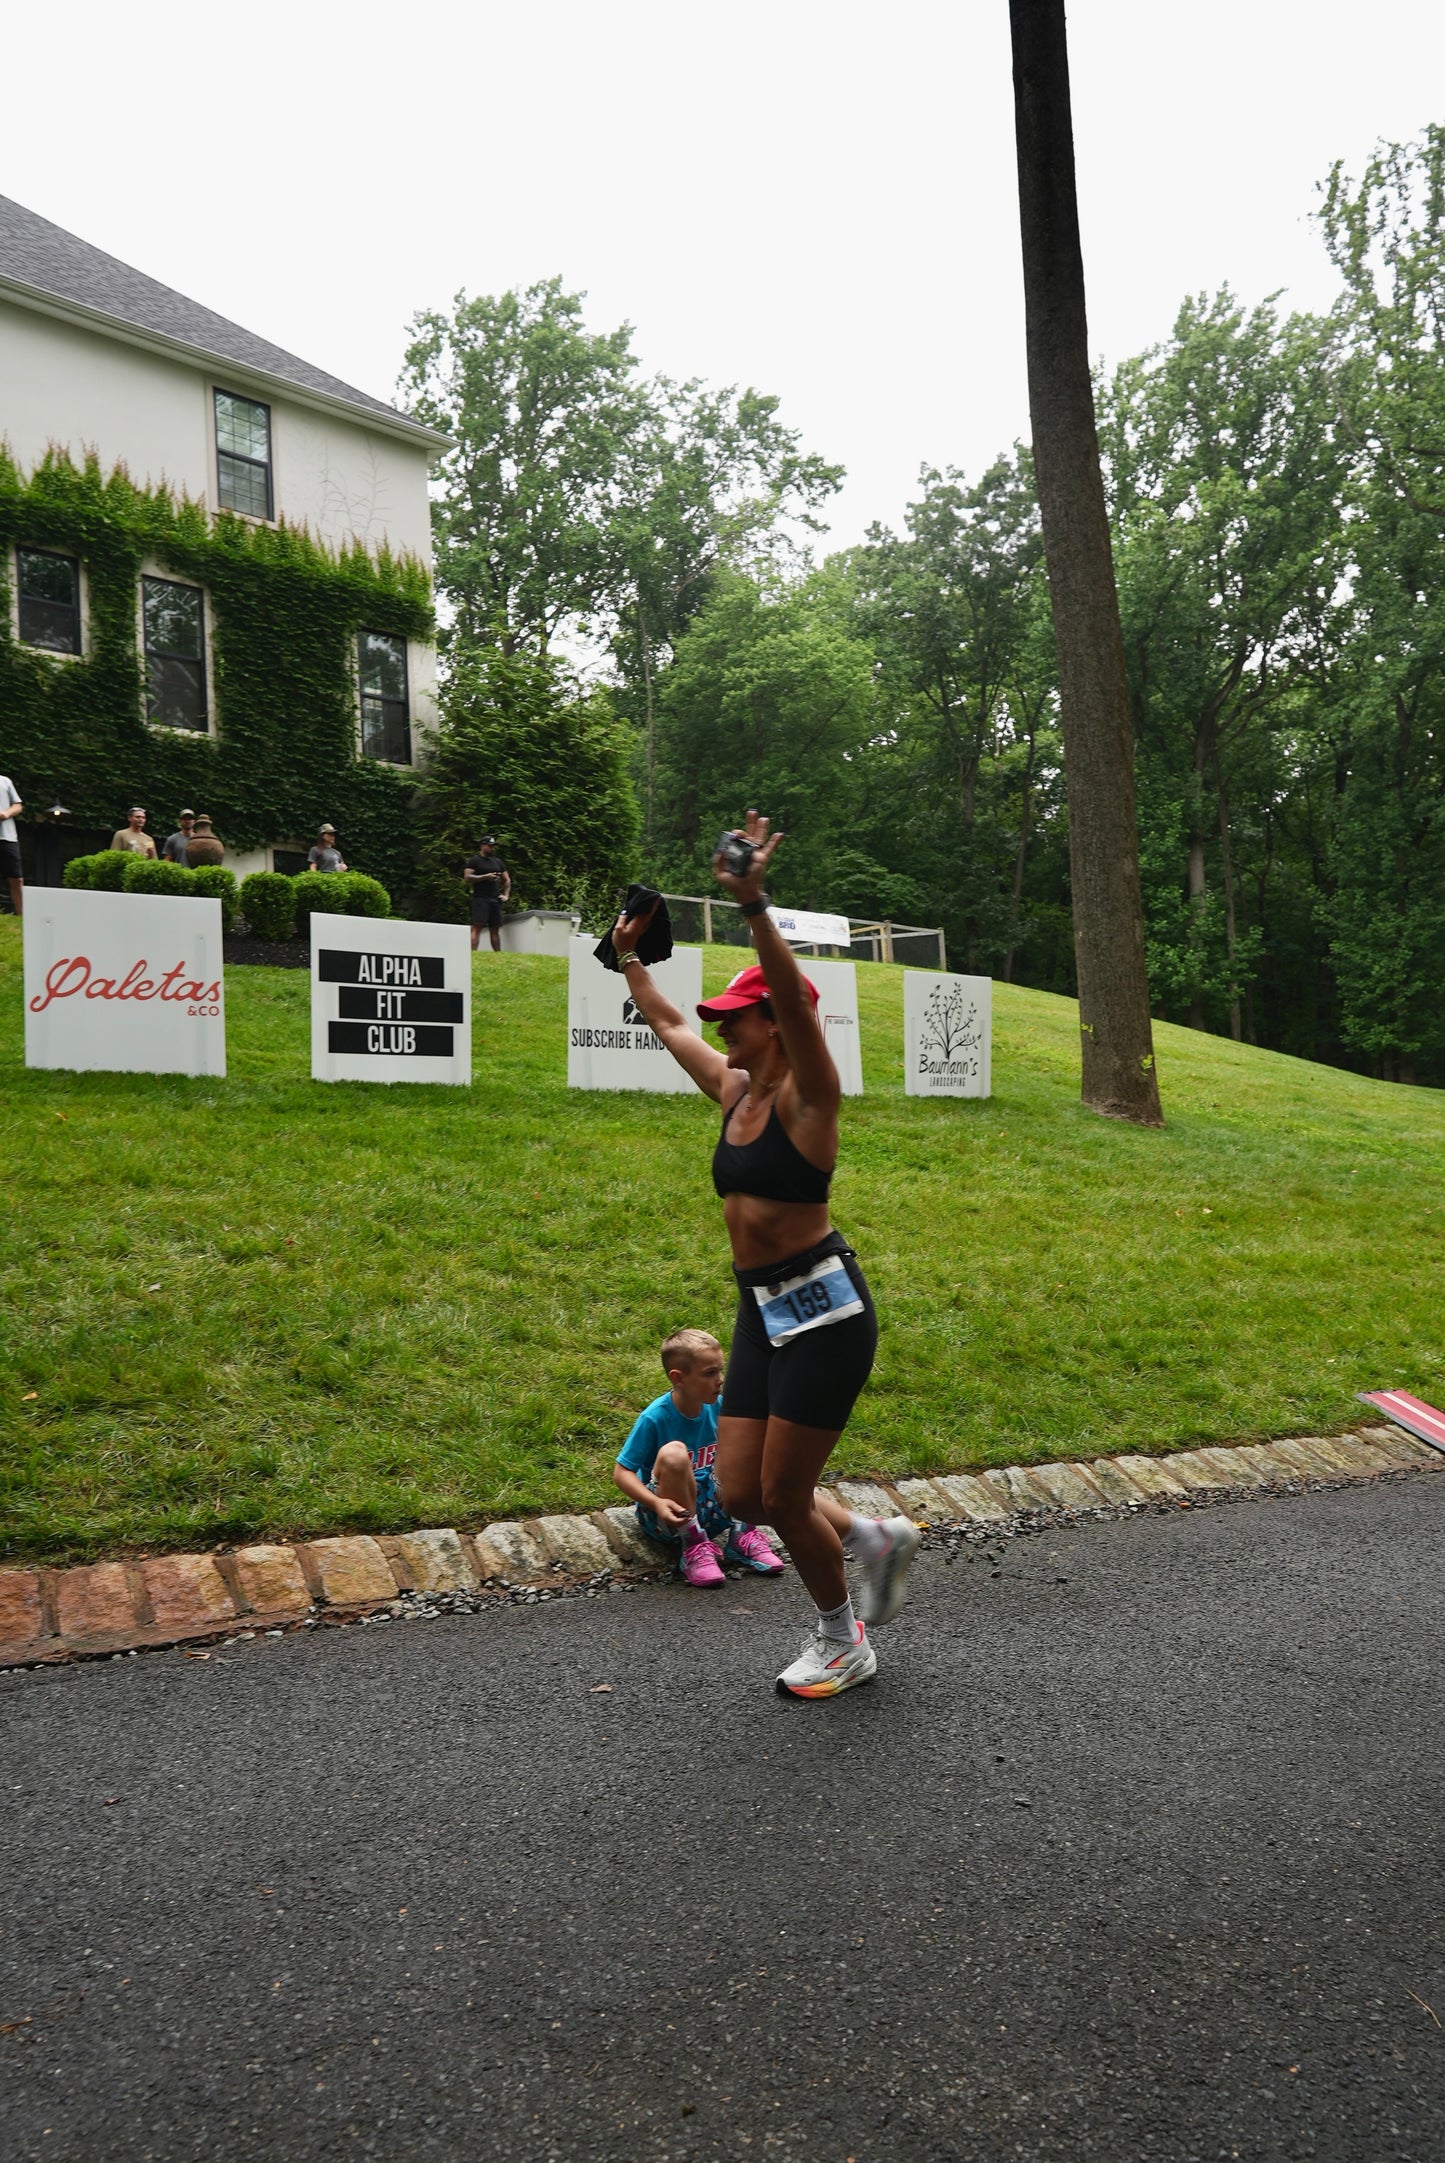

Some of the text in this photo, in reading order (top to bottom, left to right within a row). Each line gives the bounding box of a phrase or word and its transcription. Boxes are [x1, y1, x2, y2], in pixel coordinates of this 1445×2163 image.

[358, 955, 422, 985] ALPHA
[29, 956, 221, 1013] Paletas
[187, 1005, 220, 1017] &CO
[376, 991, 406, 1019] FIT
[367, 1025, 416, 1054] CLUB
[571, 1028, 632, 1050] SUBSCRIBE
[918, 1053, 979, 1077] Baumann's
[783, 1280, 833, 1324] 159
